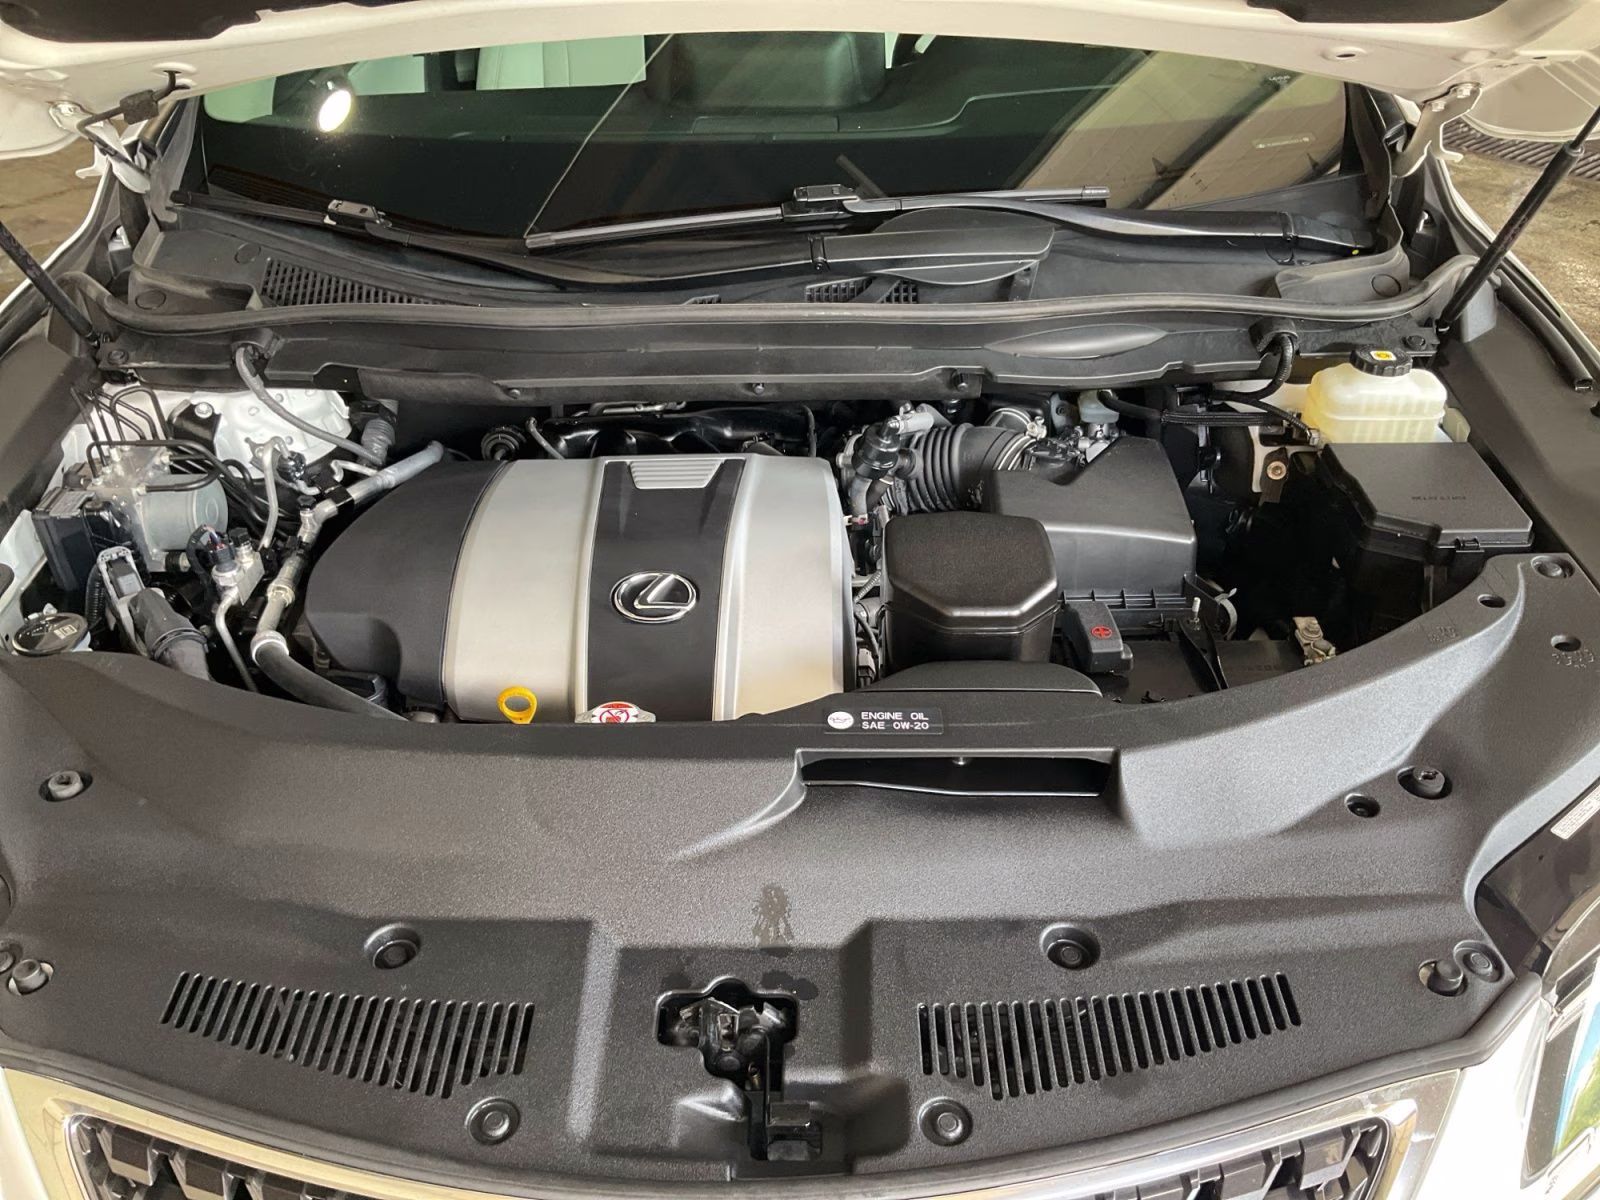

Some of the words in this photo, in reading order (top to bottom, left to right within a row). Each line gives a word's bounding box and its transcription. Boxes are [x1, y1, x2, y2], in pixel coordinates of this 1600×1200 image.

[861, 712, 903, 720] ENGINE
[910, 712, 929, 720] OIL
[862, 722, 885, 730] SAE
[893, 722, 930, 730] 0W-20
